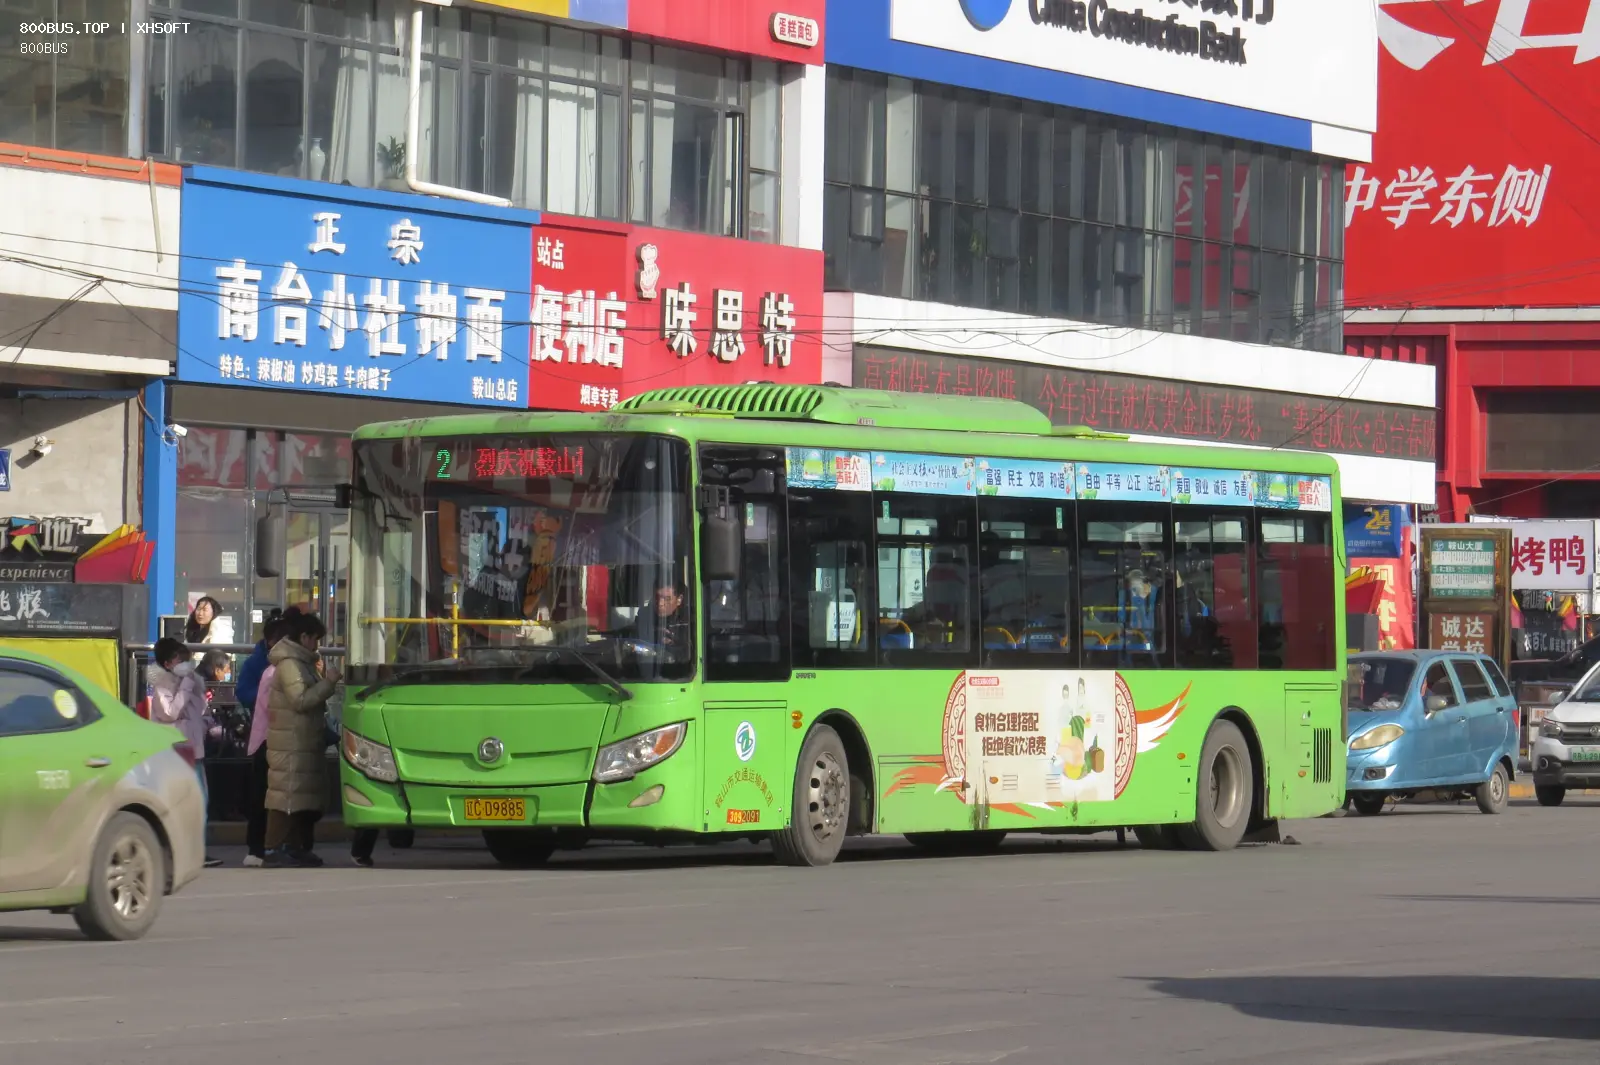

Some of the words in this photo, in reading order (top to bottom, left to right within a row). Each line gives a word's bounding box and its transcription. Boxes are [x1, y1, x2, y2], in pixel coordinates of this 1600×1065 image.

[779, 17, 813, 42] 蛋糕面包
[1088, 0, 1199, 56] Construction
[1199, 20, 1247, 66] Bank
[1344, 164, 1552, 230] 中学东侧
[537, 236, 565, 270] 站点
[215, 259, 506, 365] 南台小杜抻面
[660, 282, 796, 367] 味思特
[531, 285, 626, 368] 便利店
[258, 357, 296, 384] 辣椒油
[302, 361, 338, 387] 炒鸡架
[472, 376, 518, 402] 鞍山总店
[580, 384, 619, 409] 烟草专卖
[436, 448, 451, 479] 2
[476, 446, 584, 477] 烈庆祝鞍山
[985, 468, 1001, 486] 富强
[1008, 470, 1023, 487] 民主
[1029, 471, 1044, 488] 文明
[1050, 472, 1065, 489] 和谐
[1086, 473, 1100, 490] 自由
[1106, 474, 1120, 490] 平等
[1127, 475, 1141, 491] 公正
[1147, 475, 1161, 492] 法治
[1176, 478, 1191, 494] 爱国
[1195, 478, 1208, 495] 敬业
[1213, 479, 1227, 496] 诚信
[1233, 480, 1247, 497] 友善
[1365, 509, 1392, 530] 24
[1448, 540, 1483, 551] 鞍山大厦
[1511, 535, 1586, 577] 烤鸭
[1440, 616, 1485, 638] 诚达
[974, 712, 1039, 732] 食物合理搭配
[982, 736, 1047, 757] 拒绝餐饮浪费
